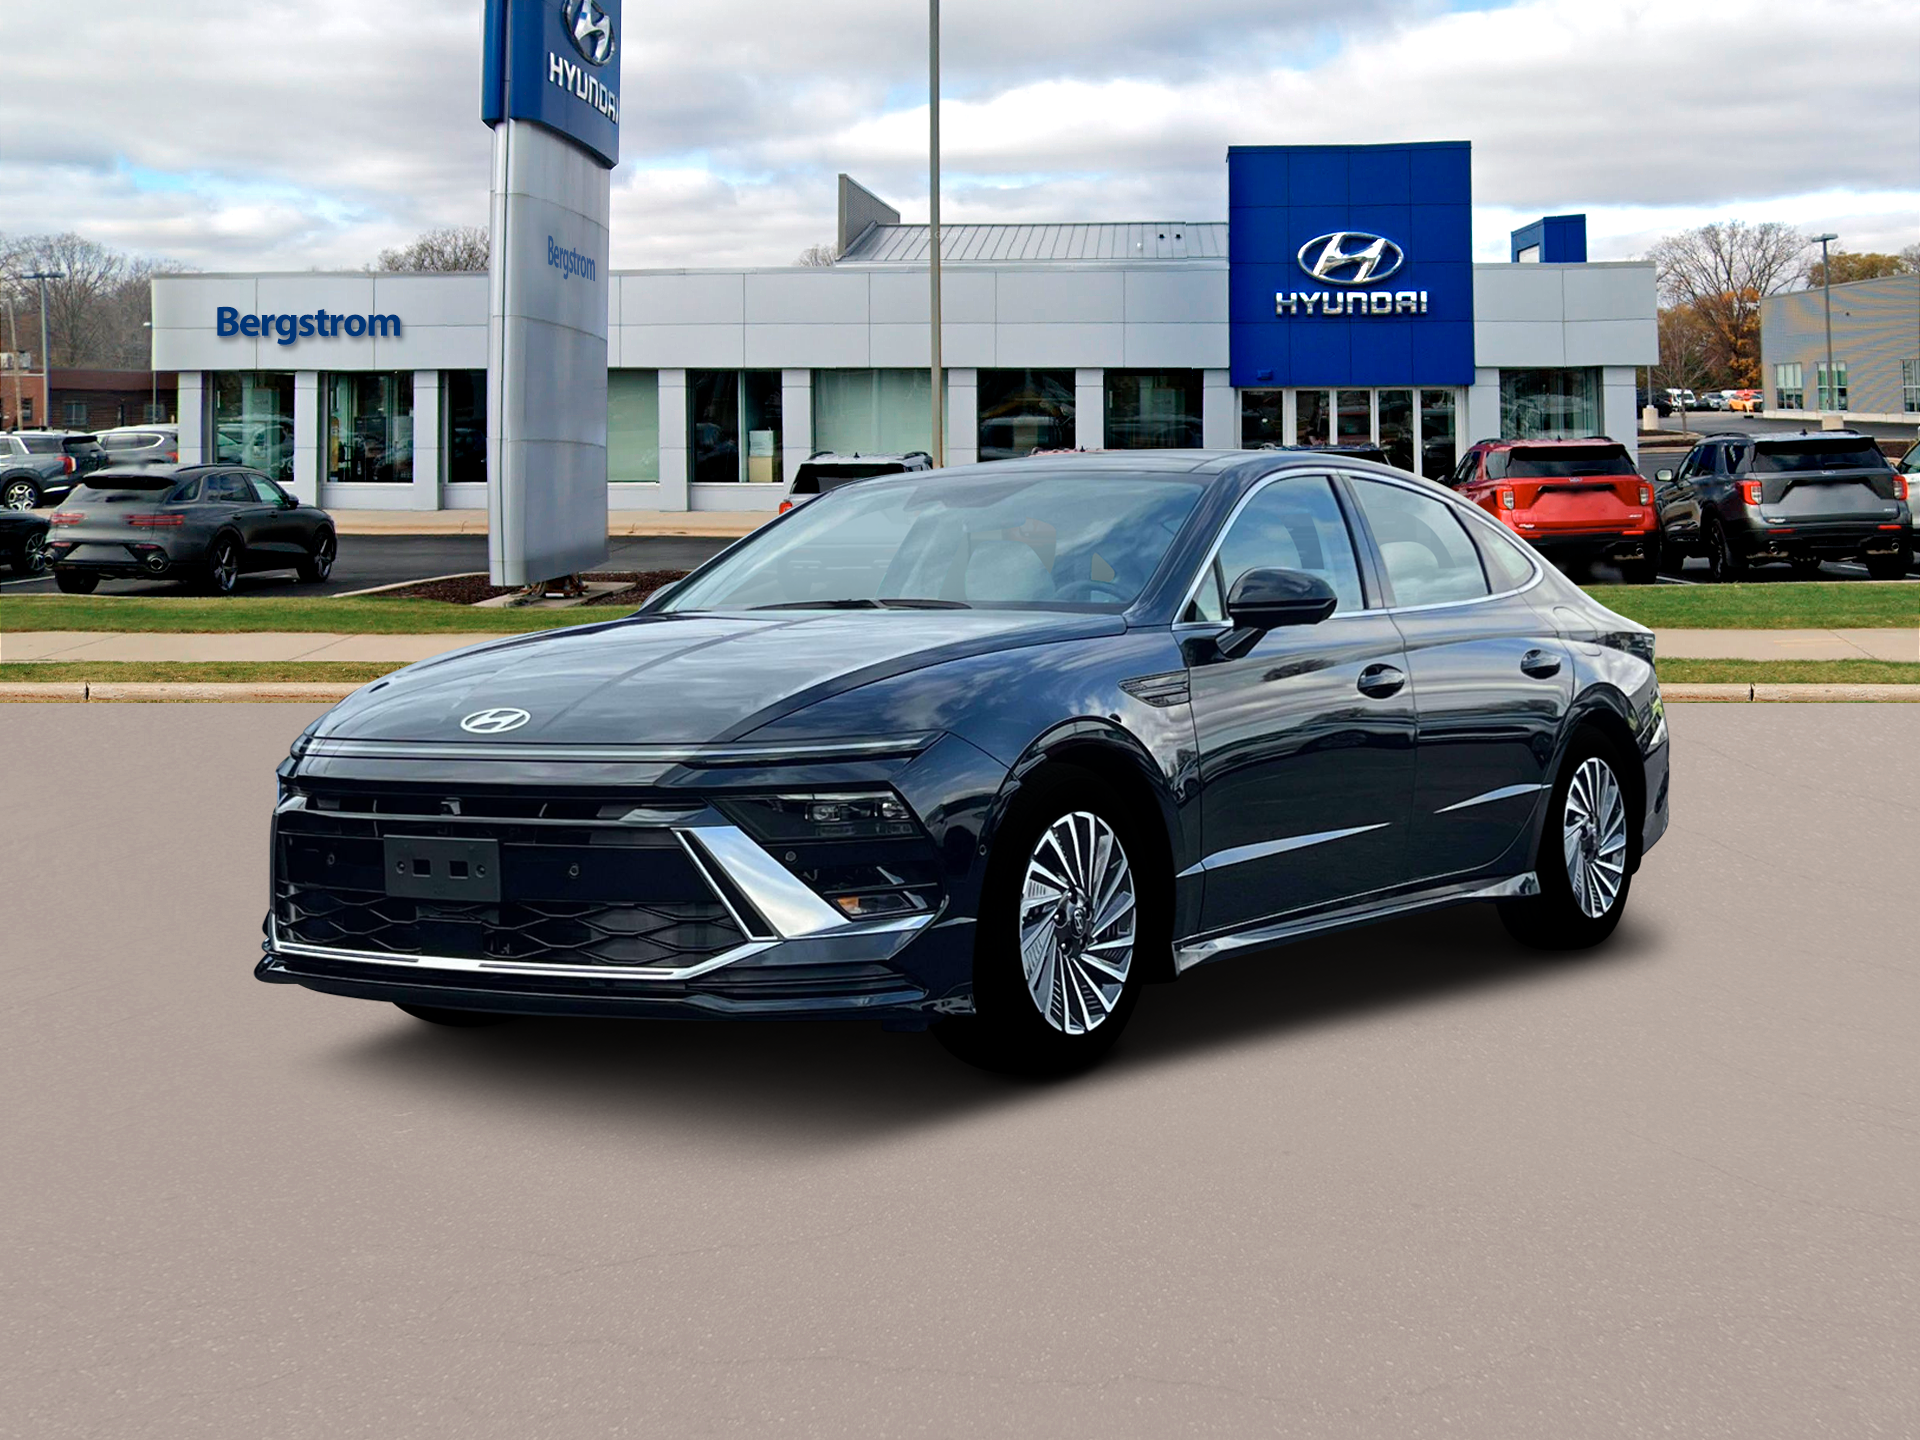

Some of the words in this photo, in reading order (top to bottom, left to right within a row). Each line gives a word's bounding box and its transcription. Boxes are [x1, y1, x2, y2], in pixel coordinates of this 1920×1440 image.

[549, 52, 619, 124] HYUNDAI
[547, 235, 596, 282] Bergstrom
[1275, 290, 1428, 316] HYUNDAI
[217, 306, 401, 345] Bergstrom
